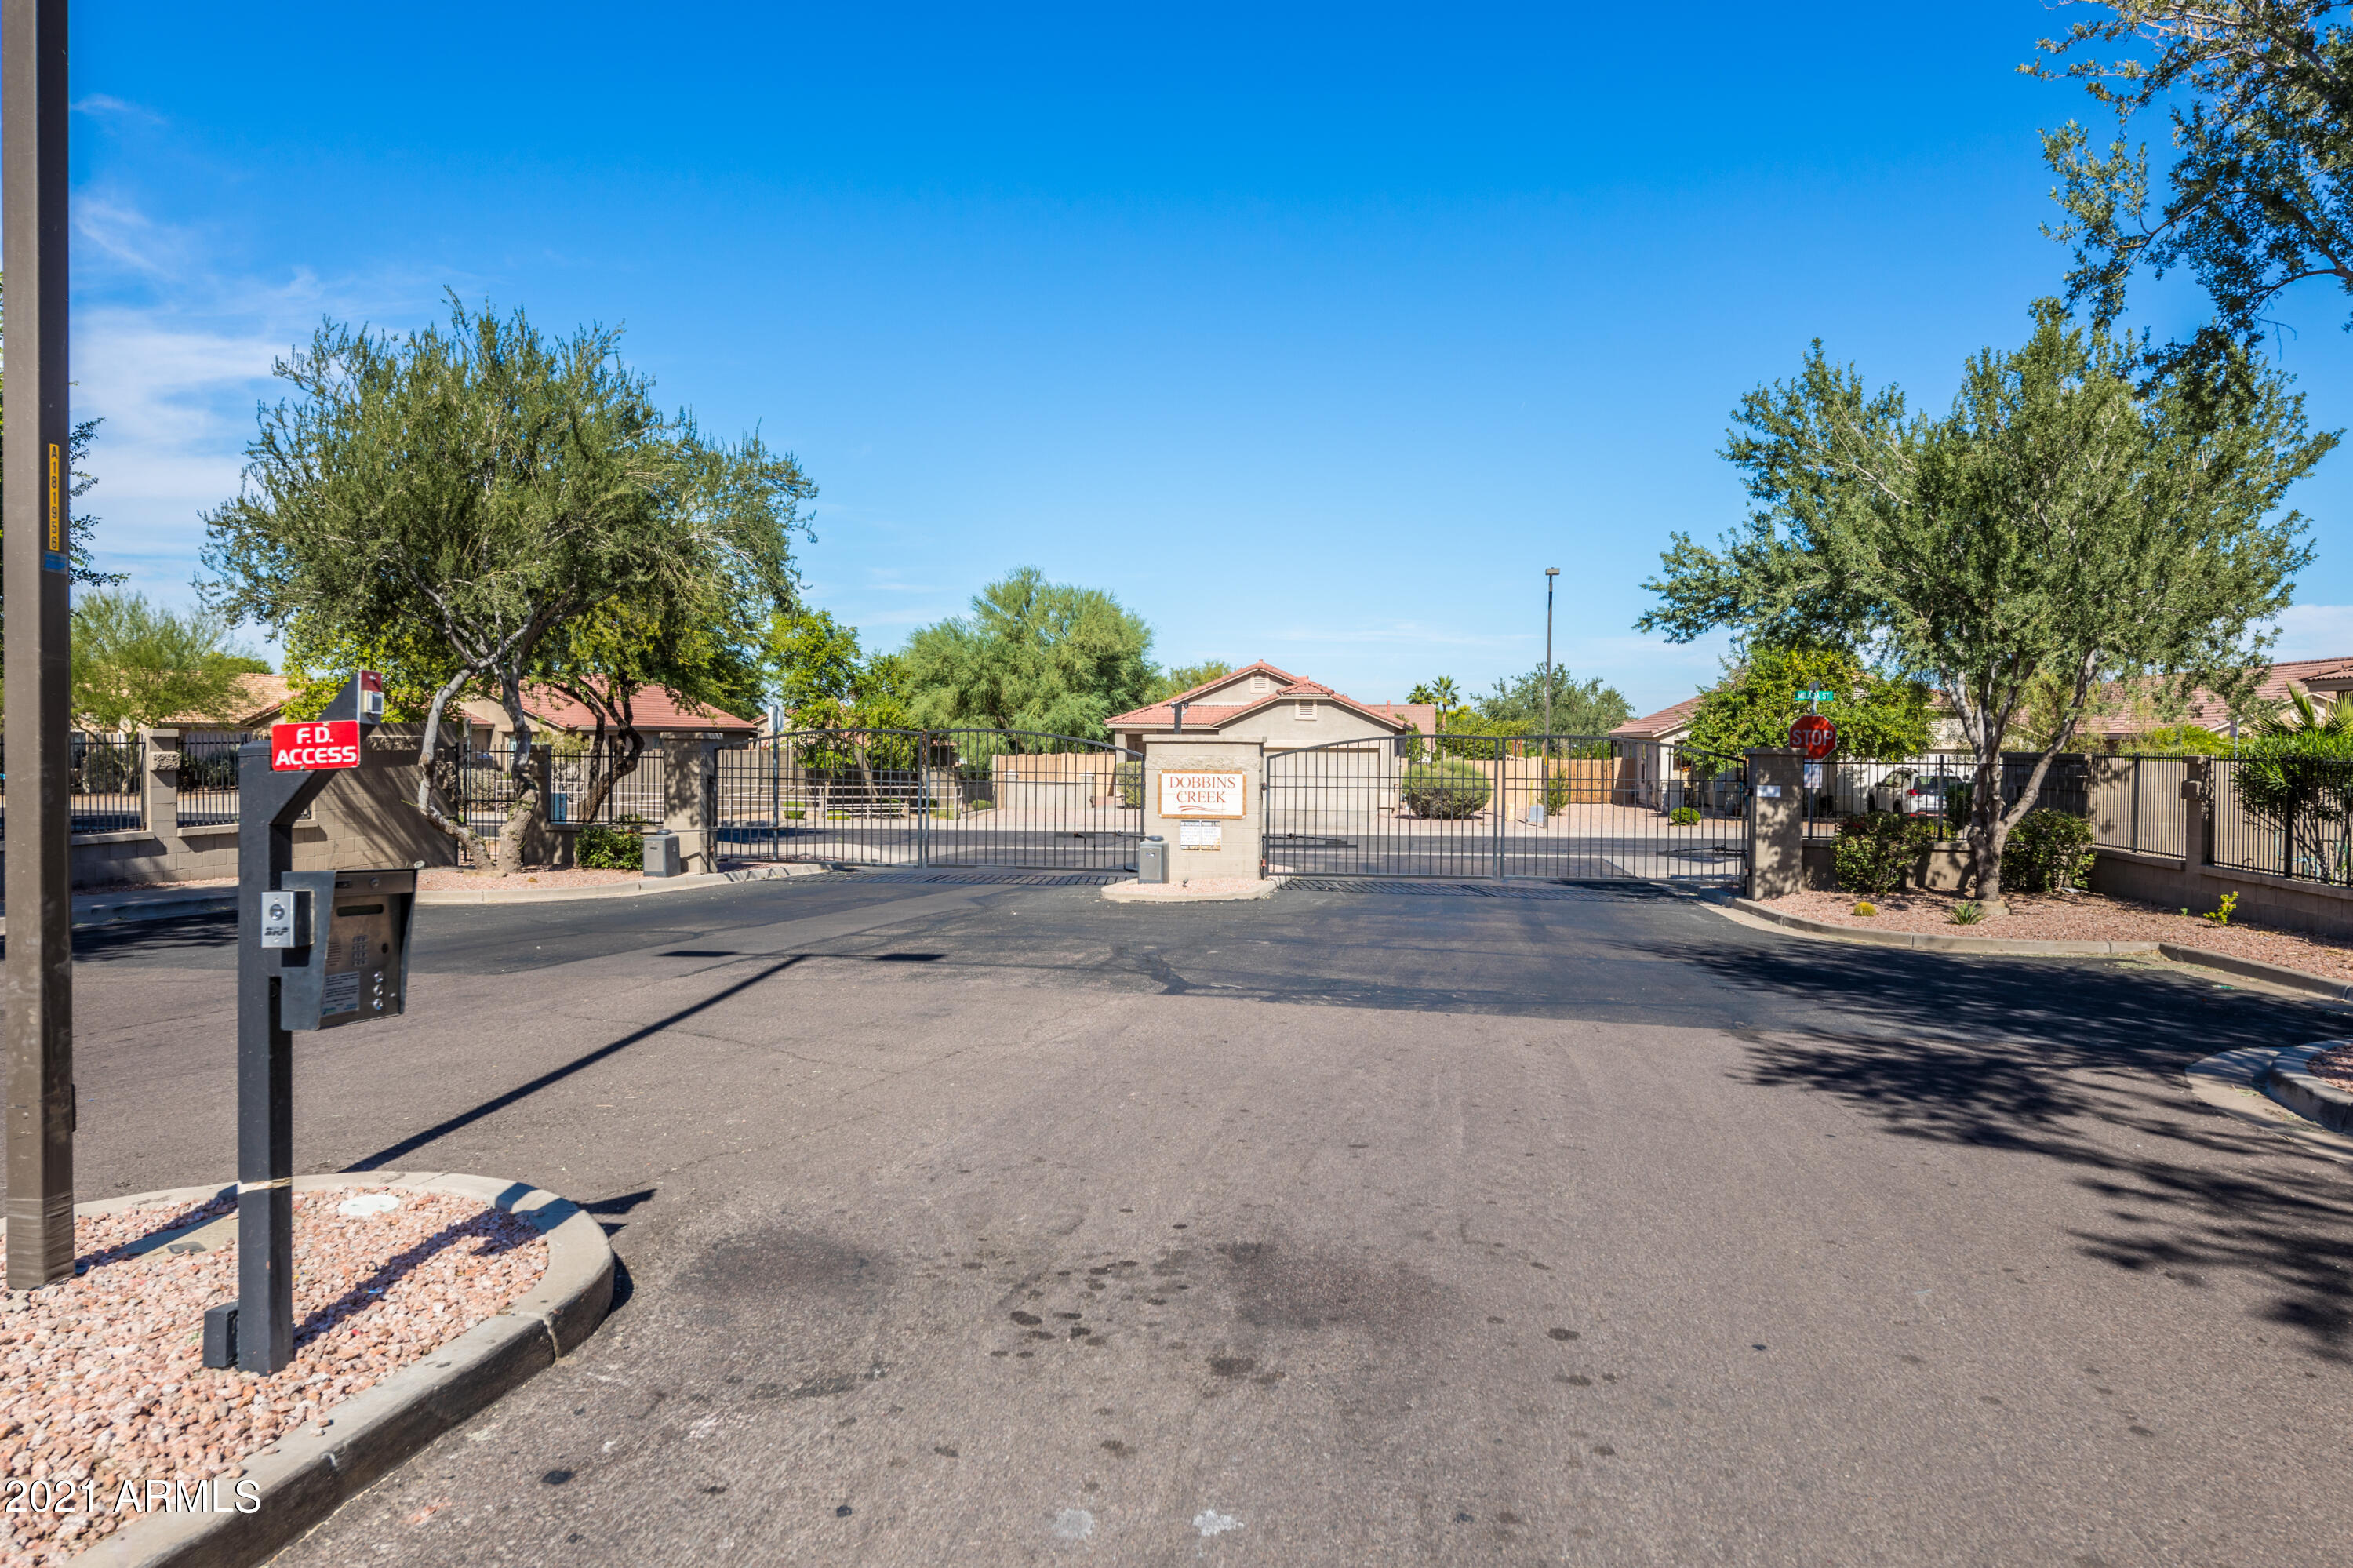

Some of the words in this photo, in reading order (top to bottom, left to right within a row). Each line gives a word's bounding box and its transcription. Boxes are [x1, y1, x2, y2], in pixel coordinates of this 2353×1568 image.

[296, 726, 334, 744] F.D.
[1792, 729, 1834, 746] STOP
[275, 745, 358, 766] ACCESS
[1169, 776, 1236, 789] DOBBINS
[1176, 791, 1227, 803] CREEK
